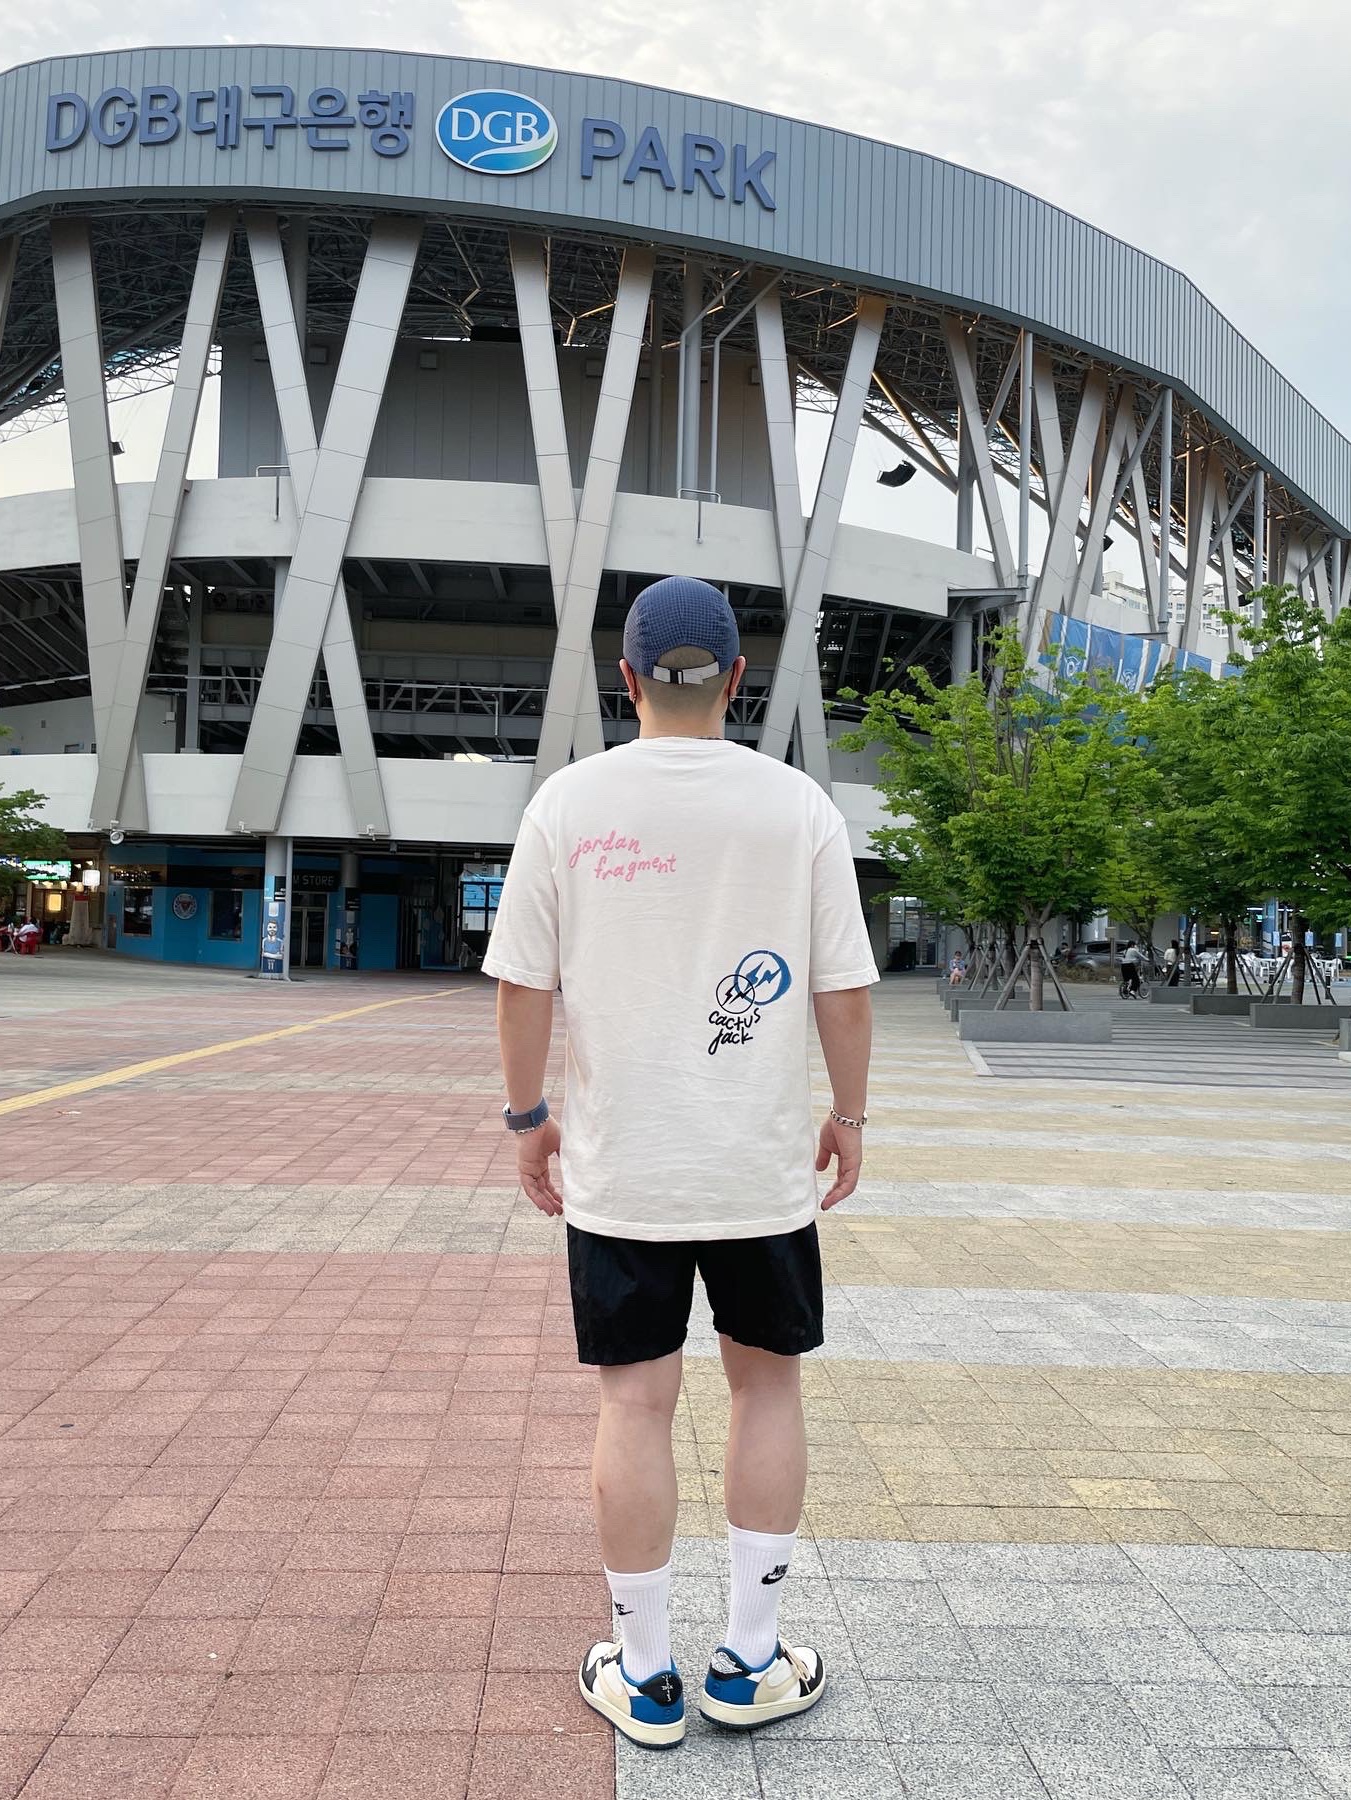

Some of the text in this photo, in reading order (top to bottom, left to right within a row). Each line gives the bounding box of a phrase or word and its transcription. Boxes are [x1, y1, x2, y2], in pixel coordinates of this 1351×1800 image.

[451, 107, 540, 145] DGB
[581, 117, 777, 211] PARK
[568, 830, 641, 869] jordan
[302, 875, 335, 886] STORE
[594, 853, 677, 882] fragment
[708, 1007, 761, 1031] cactus
[707, 1028, 754, 1056] jack
